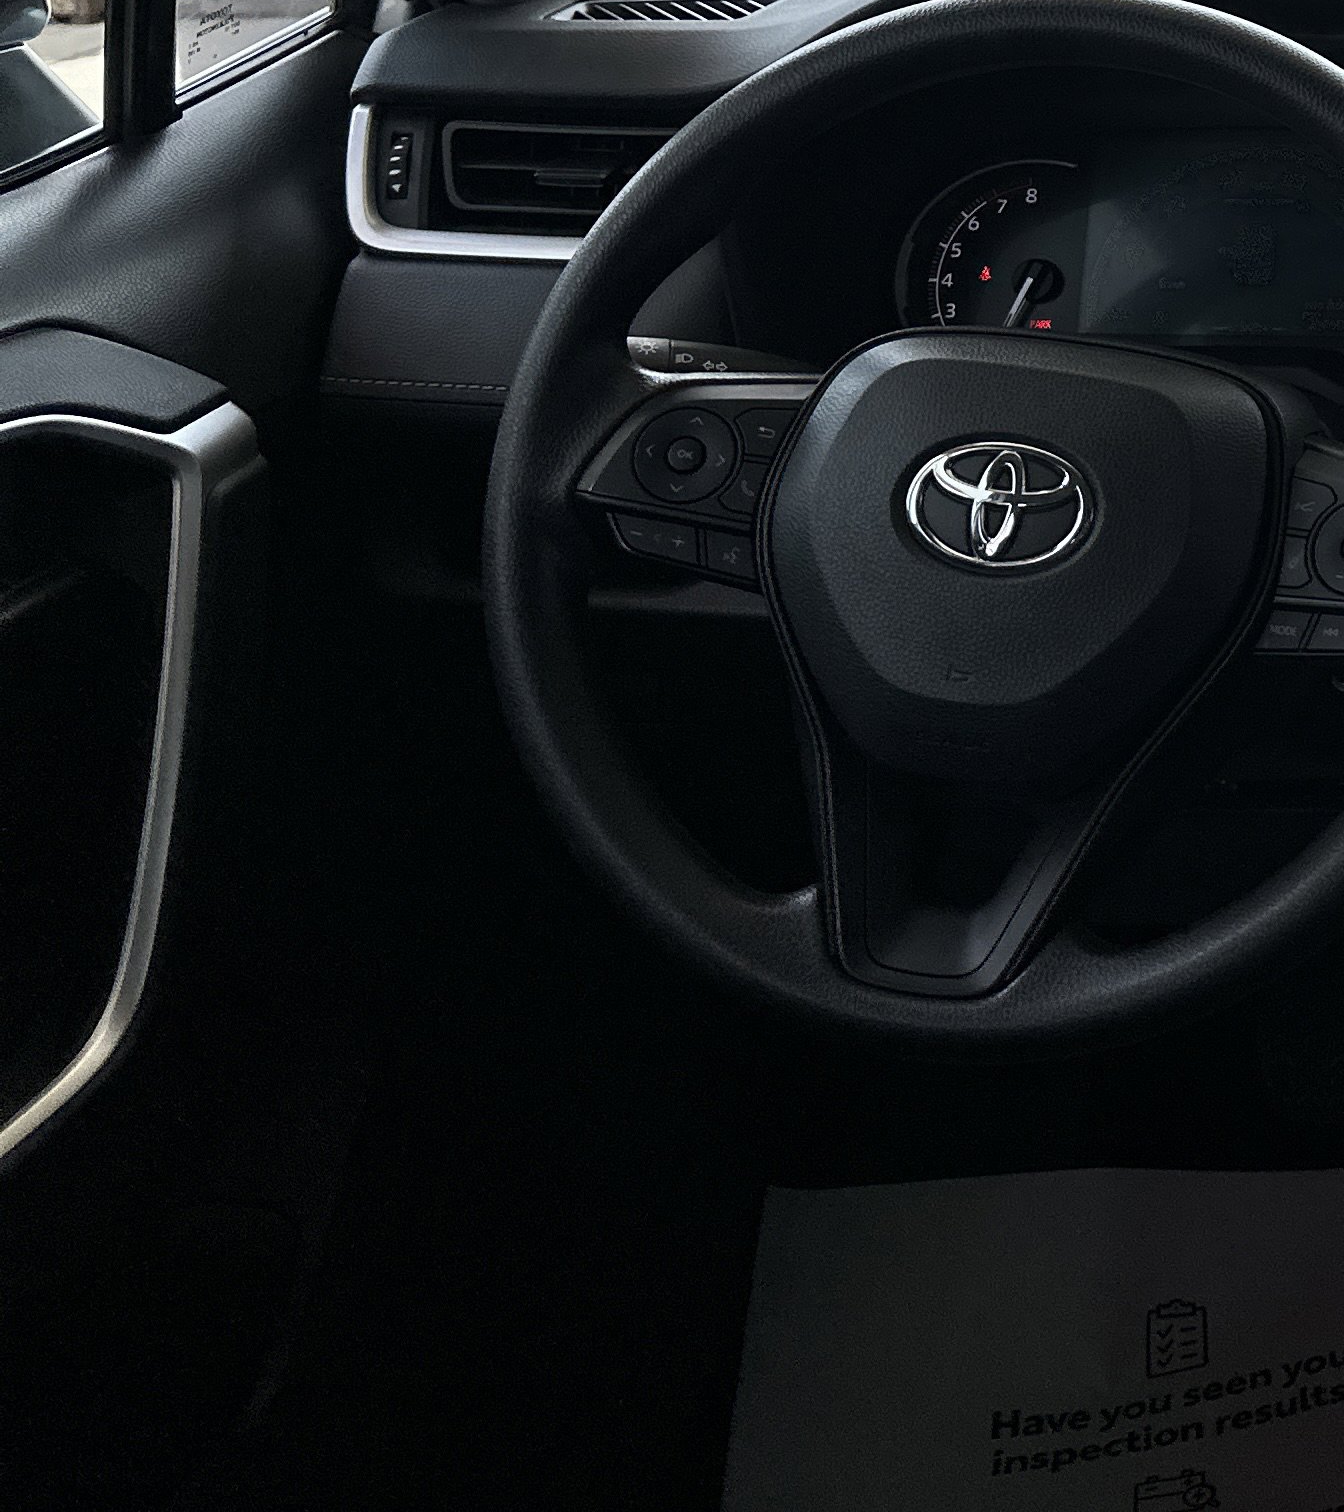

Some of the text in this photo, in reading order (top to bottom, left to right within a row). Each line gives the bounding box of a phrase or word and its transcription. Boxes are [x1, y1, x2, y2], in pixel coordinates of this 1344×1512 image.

[1025, 188, 1038, 204] 8
[997, 199, 1009, 214] 7
[968, 216, 981, 231] 6
[951, 242, 963, 258] 5
[941, 273, 954, 288] 4
[945, 302, 957, 319] 3
[1029, 319, 1052, 330] PARK
[677, 449, 694, 461] OK
[1269, 623, 1298, 637] MODE
[991, 1403, 1092, 1440] Have
[1100, 1392, 1173, 1433] you
[1183, 1366, 1273, 1407] seen
[990, 1420, 1207, 1477] inspection
